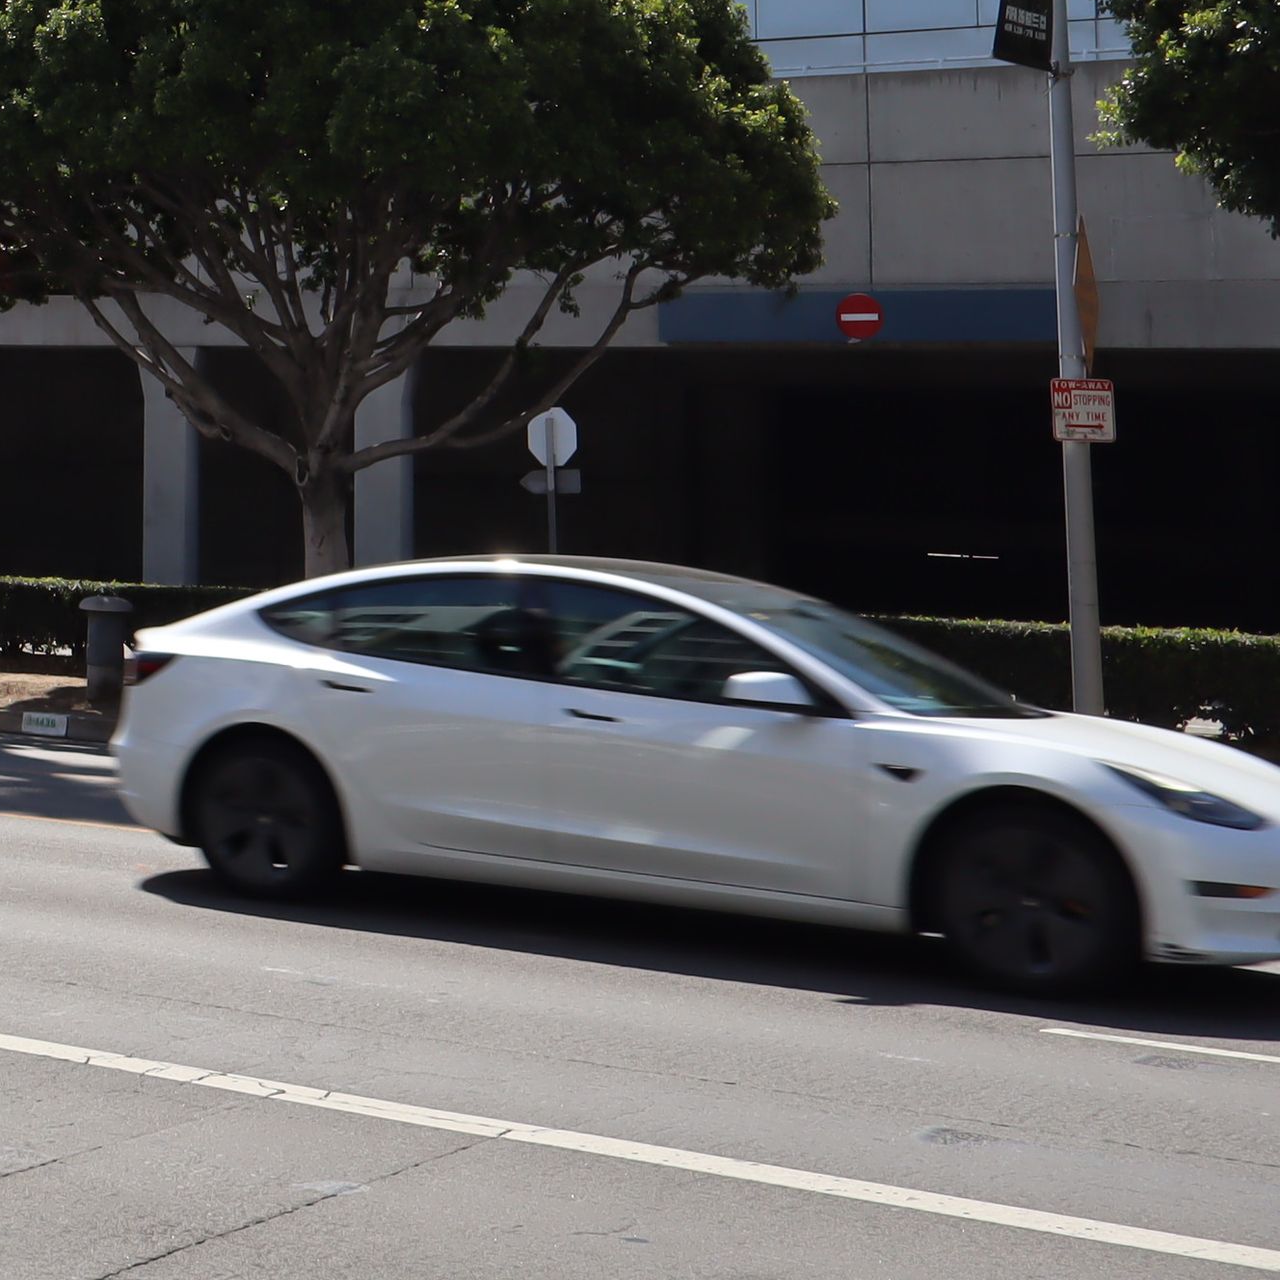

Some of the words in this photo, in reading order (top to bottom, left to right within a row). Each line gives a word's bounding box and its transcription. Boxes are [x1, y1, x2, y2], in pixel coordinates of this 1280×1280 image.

[1054, 380, 1110, 390] TOW-AWAY
[1054, 391, 1071, 407] NO
[1073, 394, 1111, 407] STOPPING
[1062, 411, 1080, 421] ANY
[1086, 411, 1107, 422] TIME
